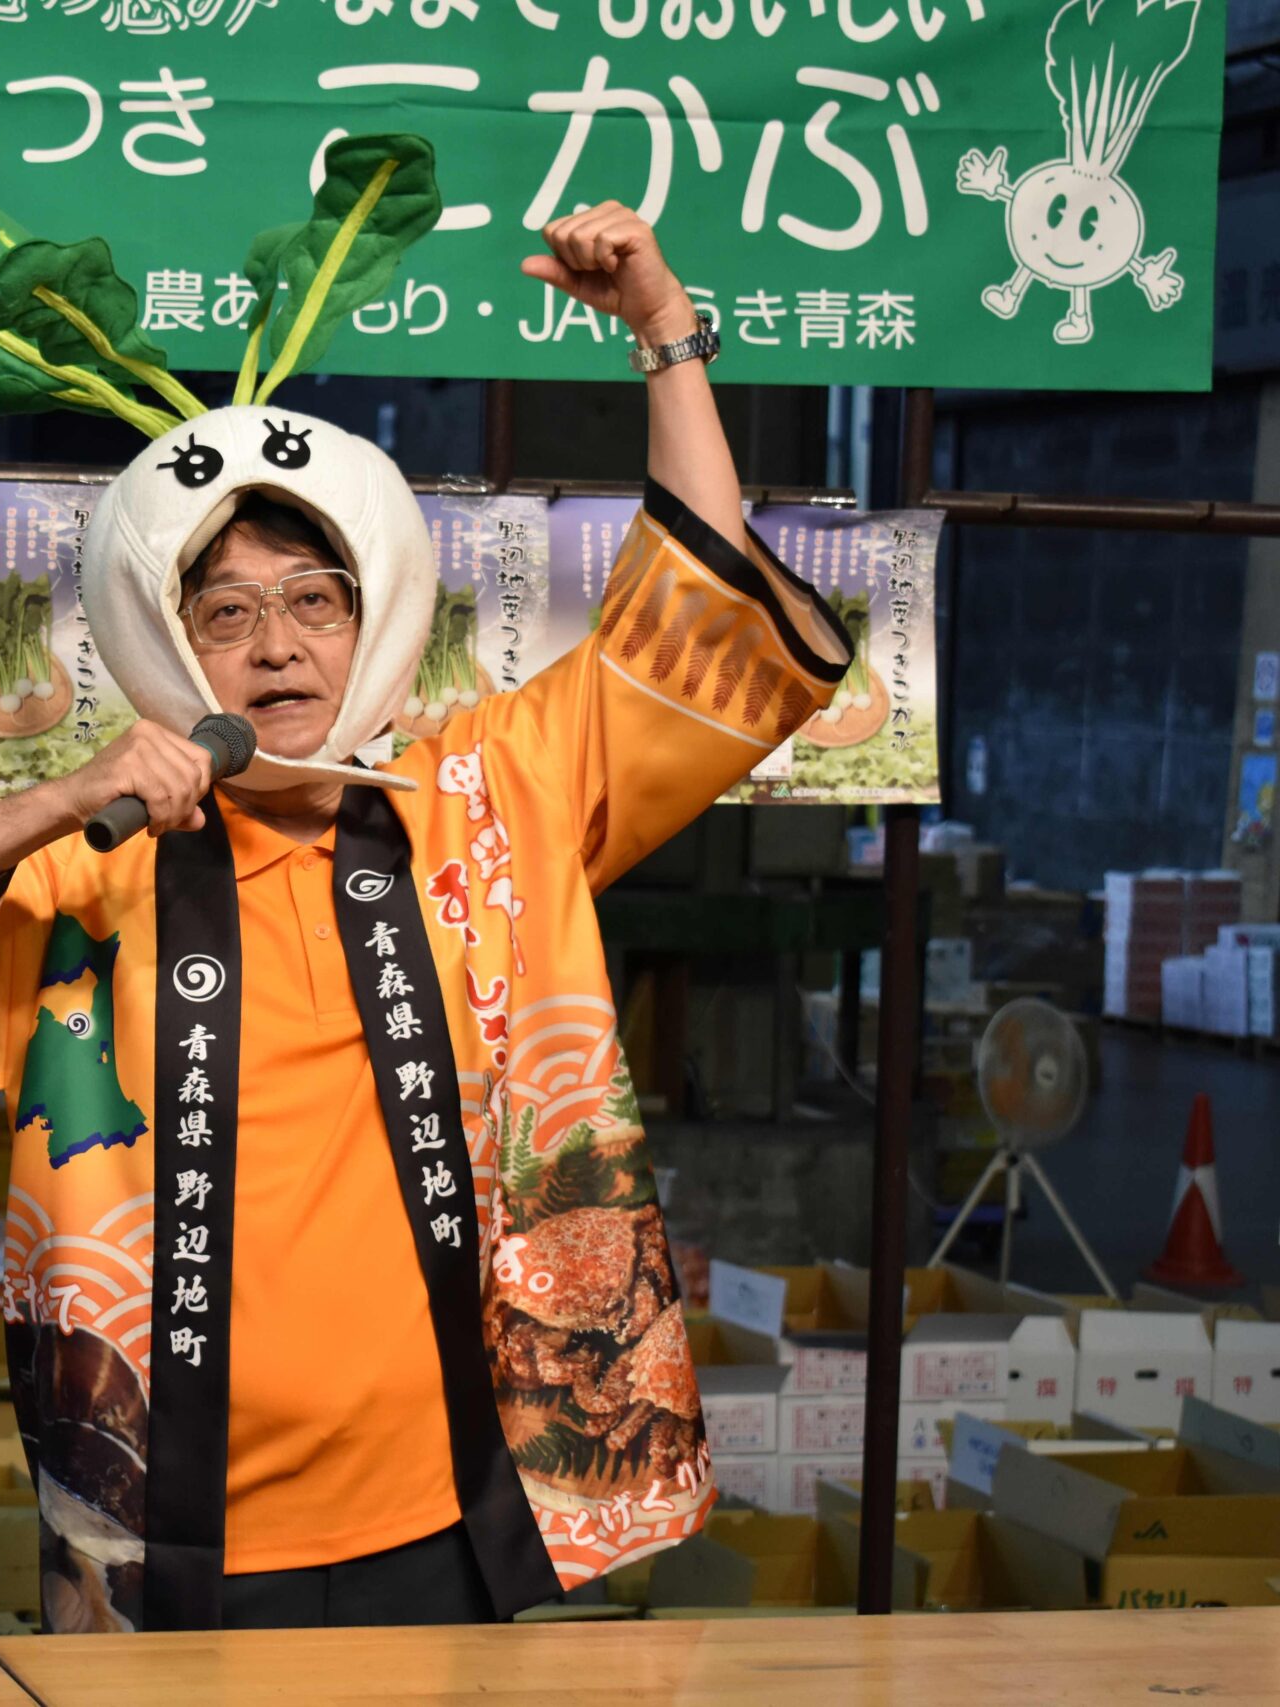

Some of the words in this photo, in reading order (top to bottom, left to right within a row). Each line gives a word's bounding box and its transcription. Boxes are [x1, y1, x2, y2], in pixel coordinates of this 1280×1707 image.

[177, 1024, 217, 1148] 青森県
[364, 921, 424, 1041] 青森県
[394, 1061, 463, 1248] 野辺地町
[170, 1168, 214, 1367] 野辺地町
